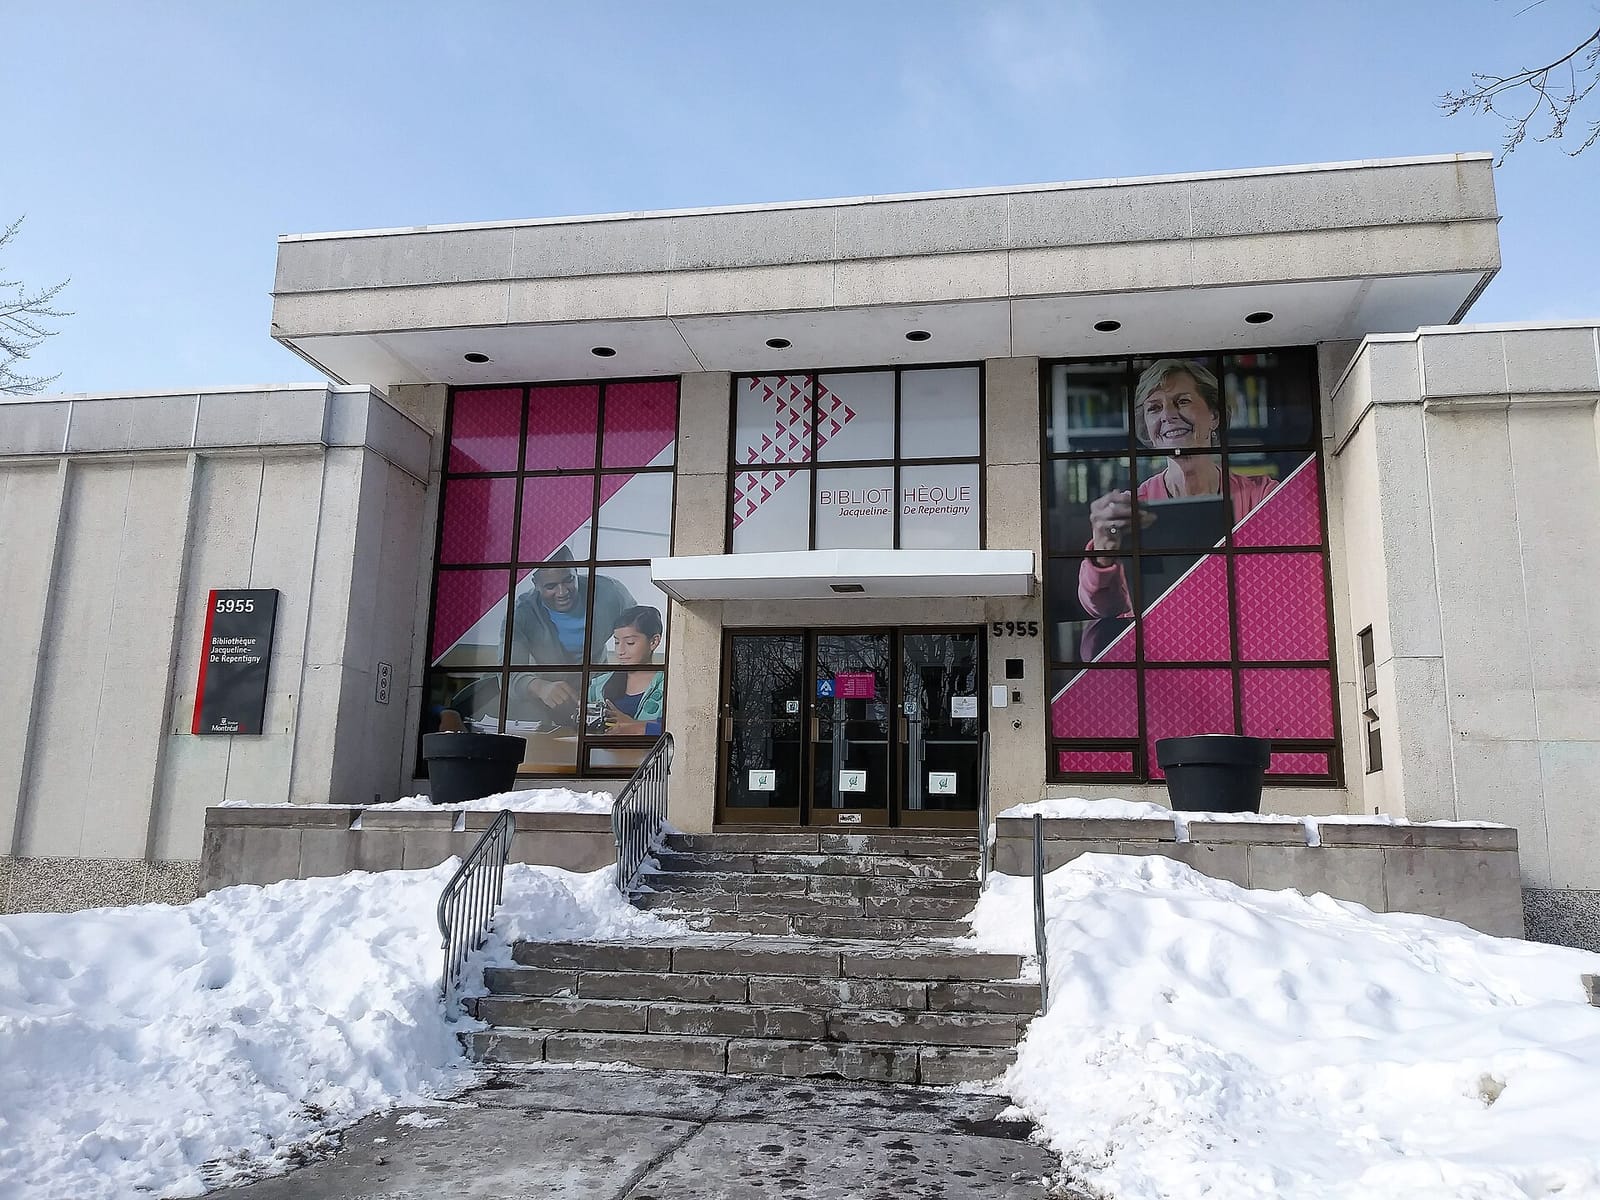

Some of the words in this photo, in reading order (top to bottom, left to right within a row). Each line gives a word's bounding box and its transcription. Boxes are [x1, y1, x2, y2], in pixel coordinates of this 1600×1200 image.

[903, 505, 916, 515] De
[918, 504, 970, 517] Repentigny
[215, 599, 254, 613] 5955
[992, 621, 1039, 638] 5955
[211, 636, 257, 647] Bibliothèque
[210, 654, 220, 662] De
[221, 654, 261, 664] Repentigny
